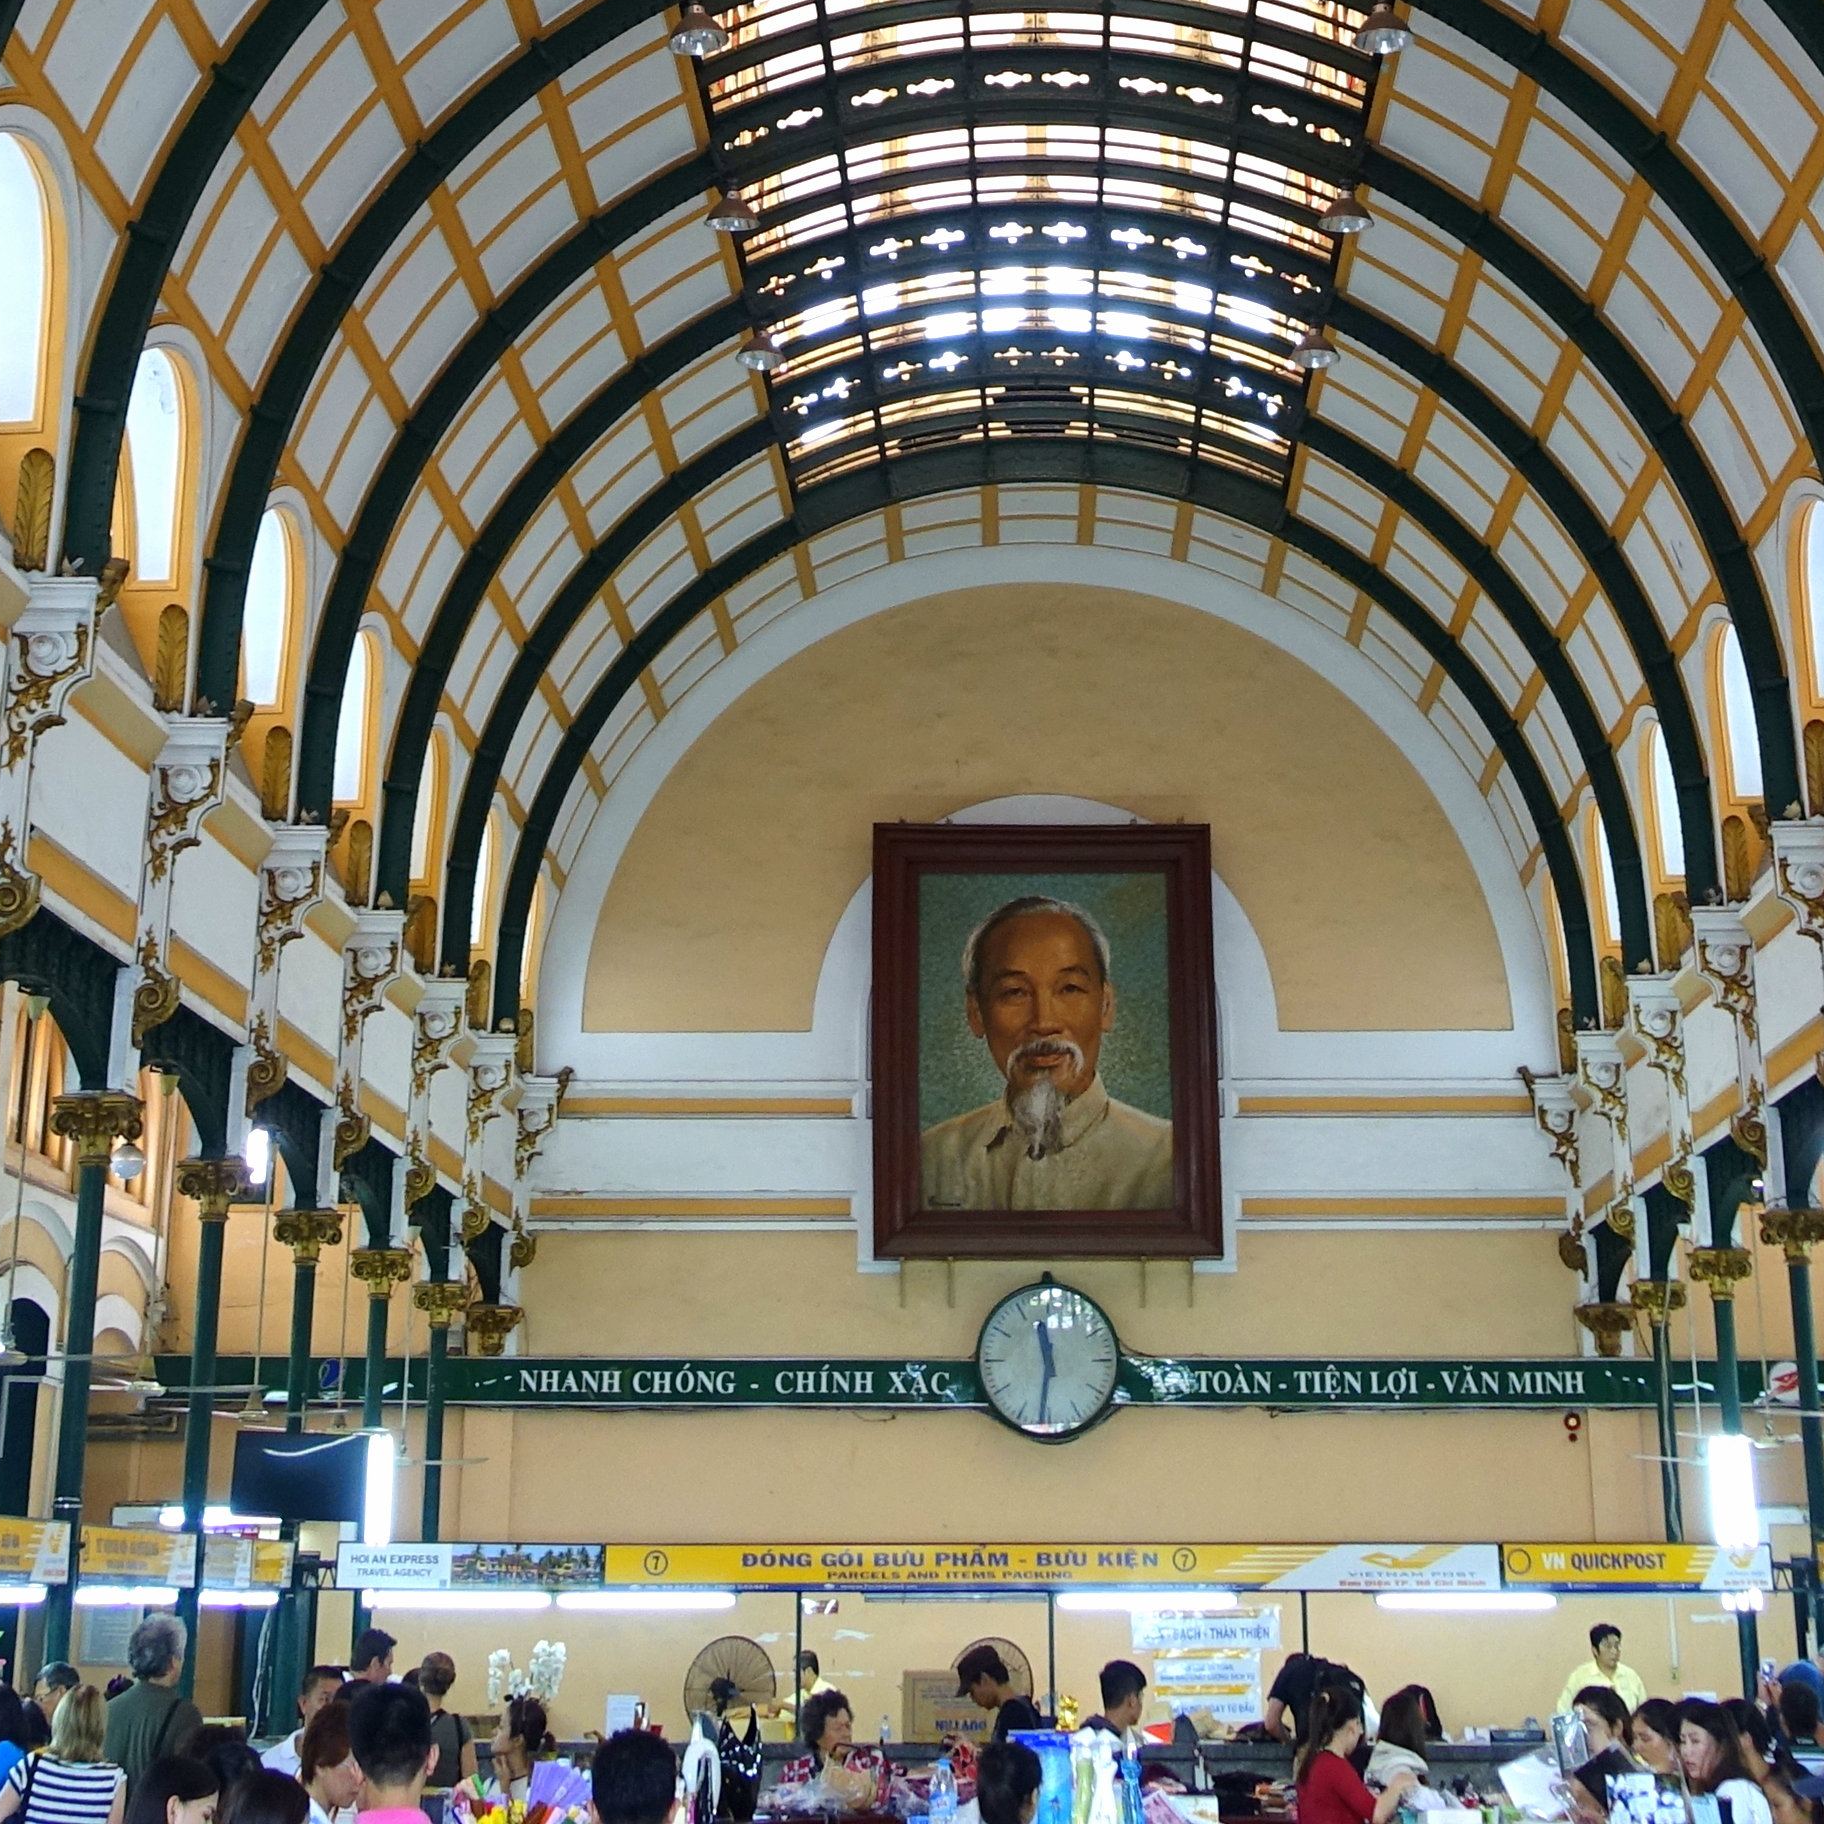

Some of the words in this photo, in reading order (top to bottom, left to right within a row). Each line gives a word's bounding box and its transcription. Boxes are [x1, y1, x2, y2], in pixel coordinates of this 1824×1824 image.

[519, 1369, 622, 1394] NHANH
[632, 1363, 736, 1395] CHÓNG
[775, 1364, 875, 1395] CHÍNH
[1194, 1364, 1273, 1395] TOÀN
[1293, 1365, 1362, 1399] TIỆN
[1370, 1368, 1419, 1399] LỢI
[1442, 1364, 1504, 1395] VĂN
[1507, 1370, 1586, 1395] MINH
[350, 1554, 370, 1564] HOI
[371, 1554, 387, 1564] AN
[389, 1554, 439, 1564] EXPRESS
[742, 1549, 812, 1567] ĐÓNG
[821, 1549, 863, 1567] GÓI
[874, 1550, 924, 1567] BƯU
[935, 1543, 1009, 1567] PHẨM
[1036, 1550, 1087, 1567] BƯU
[1097, 1549, 1158, 1570] KIỆN
[1541, 1552, 1566, 1570] VN
[1571, 1552, 1666, 1572] QUICKPOST
[357, 1568, 391, 1577] TRAVEL
[393, 1568, 432, 1577] AGENCY
[827, 1570, 900, 1579] PARCELS
[907, 1570, 939, 1579] AND
[947, 1570, 996, 1579] ITEMS
[1002, 1570, 1073, 1579] PACKING
